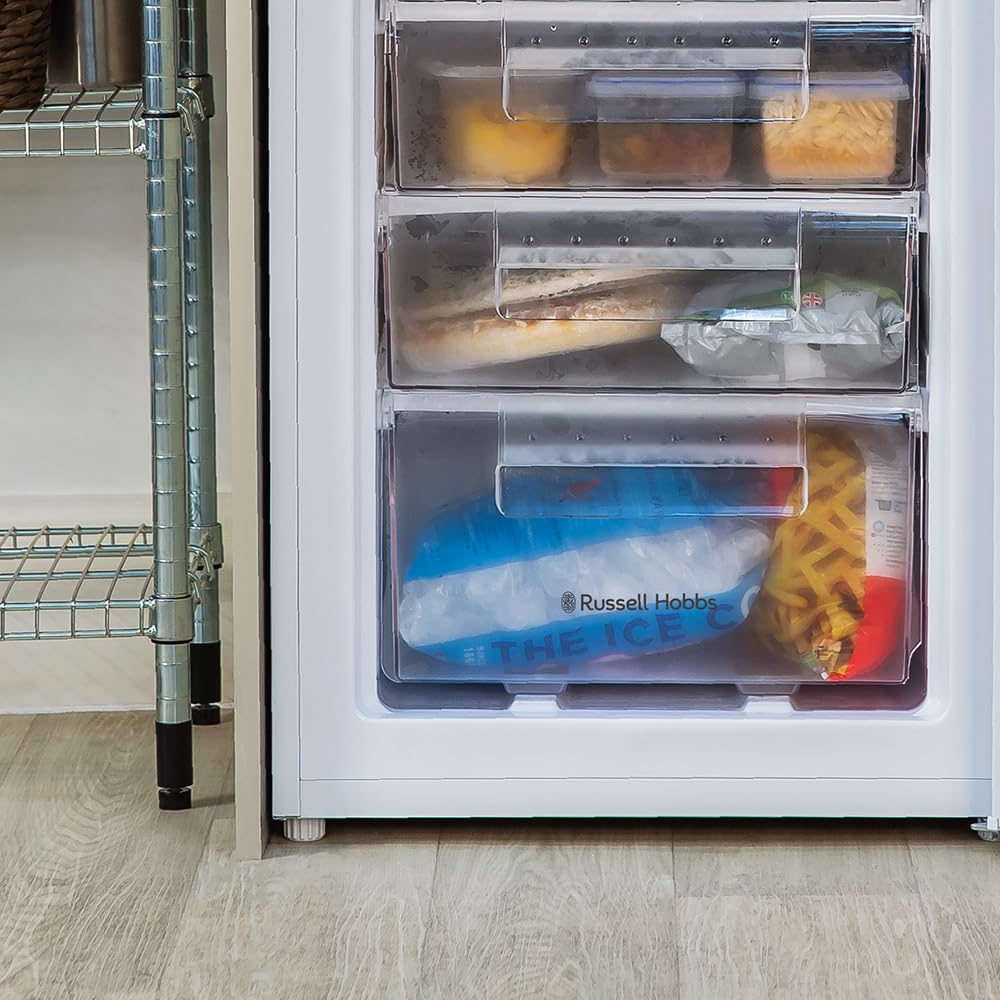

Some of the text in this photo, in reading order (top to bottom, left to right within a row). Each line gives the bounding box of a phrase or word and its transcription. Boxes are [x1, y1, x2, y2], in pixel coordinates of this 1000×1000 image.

[580, 592, 717, 611] Russell Hobbs
[491, 627, 588, 665] THE
[604, 612, 685, 648] ICE
